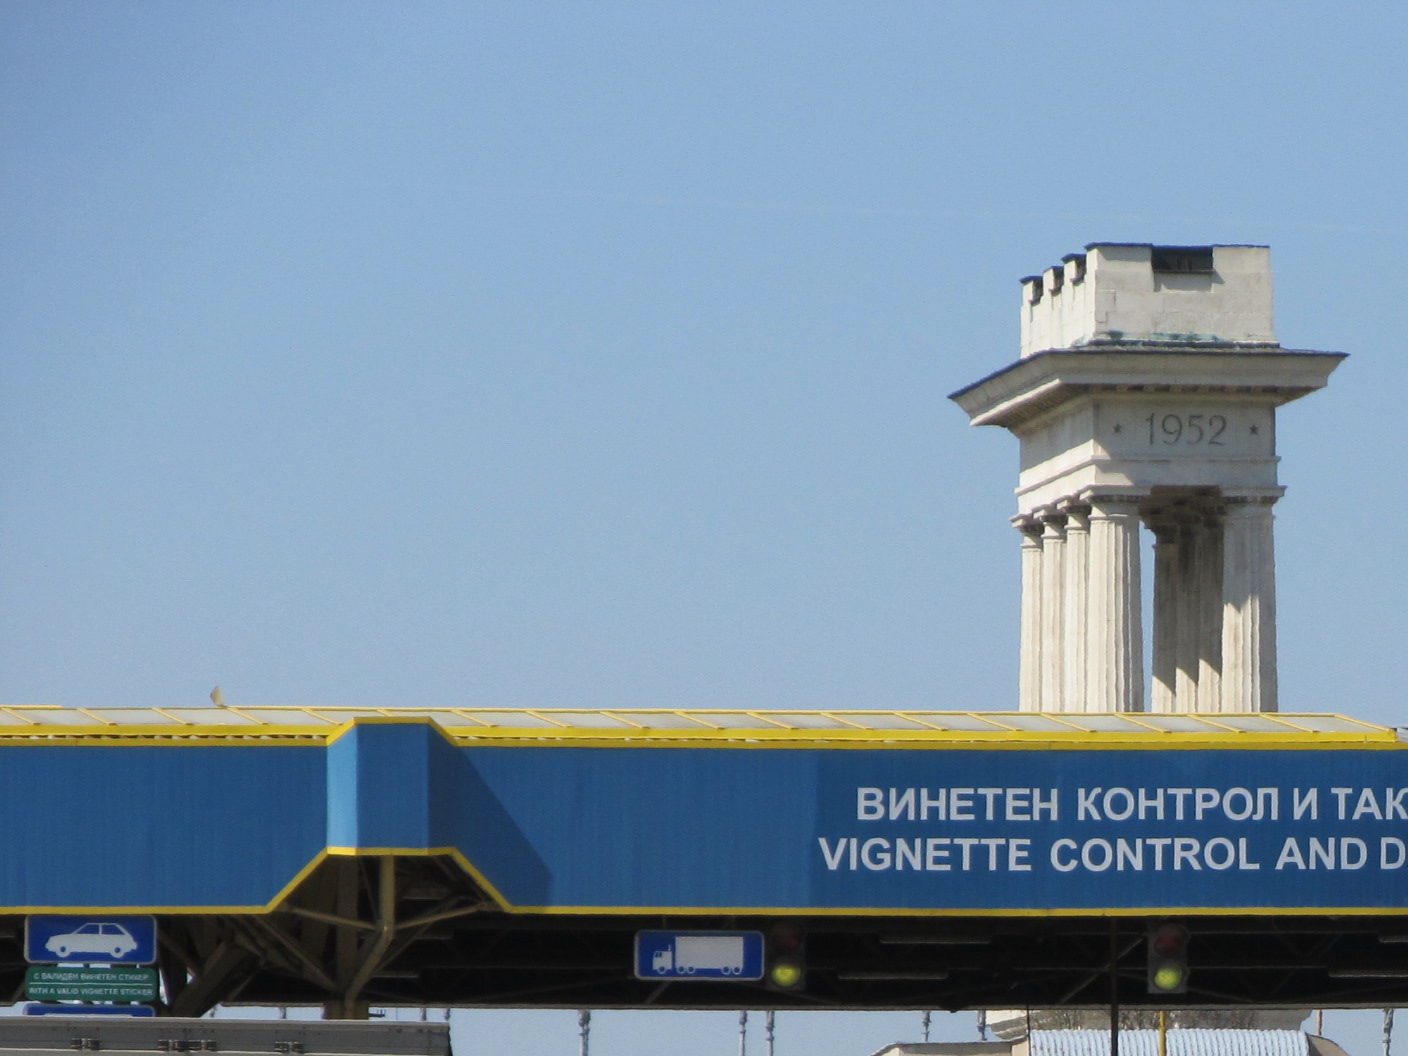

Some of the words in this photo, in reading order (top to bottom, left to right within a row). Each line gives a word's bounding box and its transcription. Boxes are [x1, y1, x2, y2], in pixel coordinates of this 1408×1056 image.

[1144, 413, 1227, 446] 1952
[856, 787, 1059, 821] ВИНЕТЕН
[1077, 787, 1279, 821] КОНТРОЛ
[1293, 787, 1318, 820] И
[818, 837, 1032, 871] VIGNETTE
[1050, 837, 1260, 871] CONTROL
[1275, 837, 1368, 870] AND
